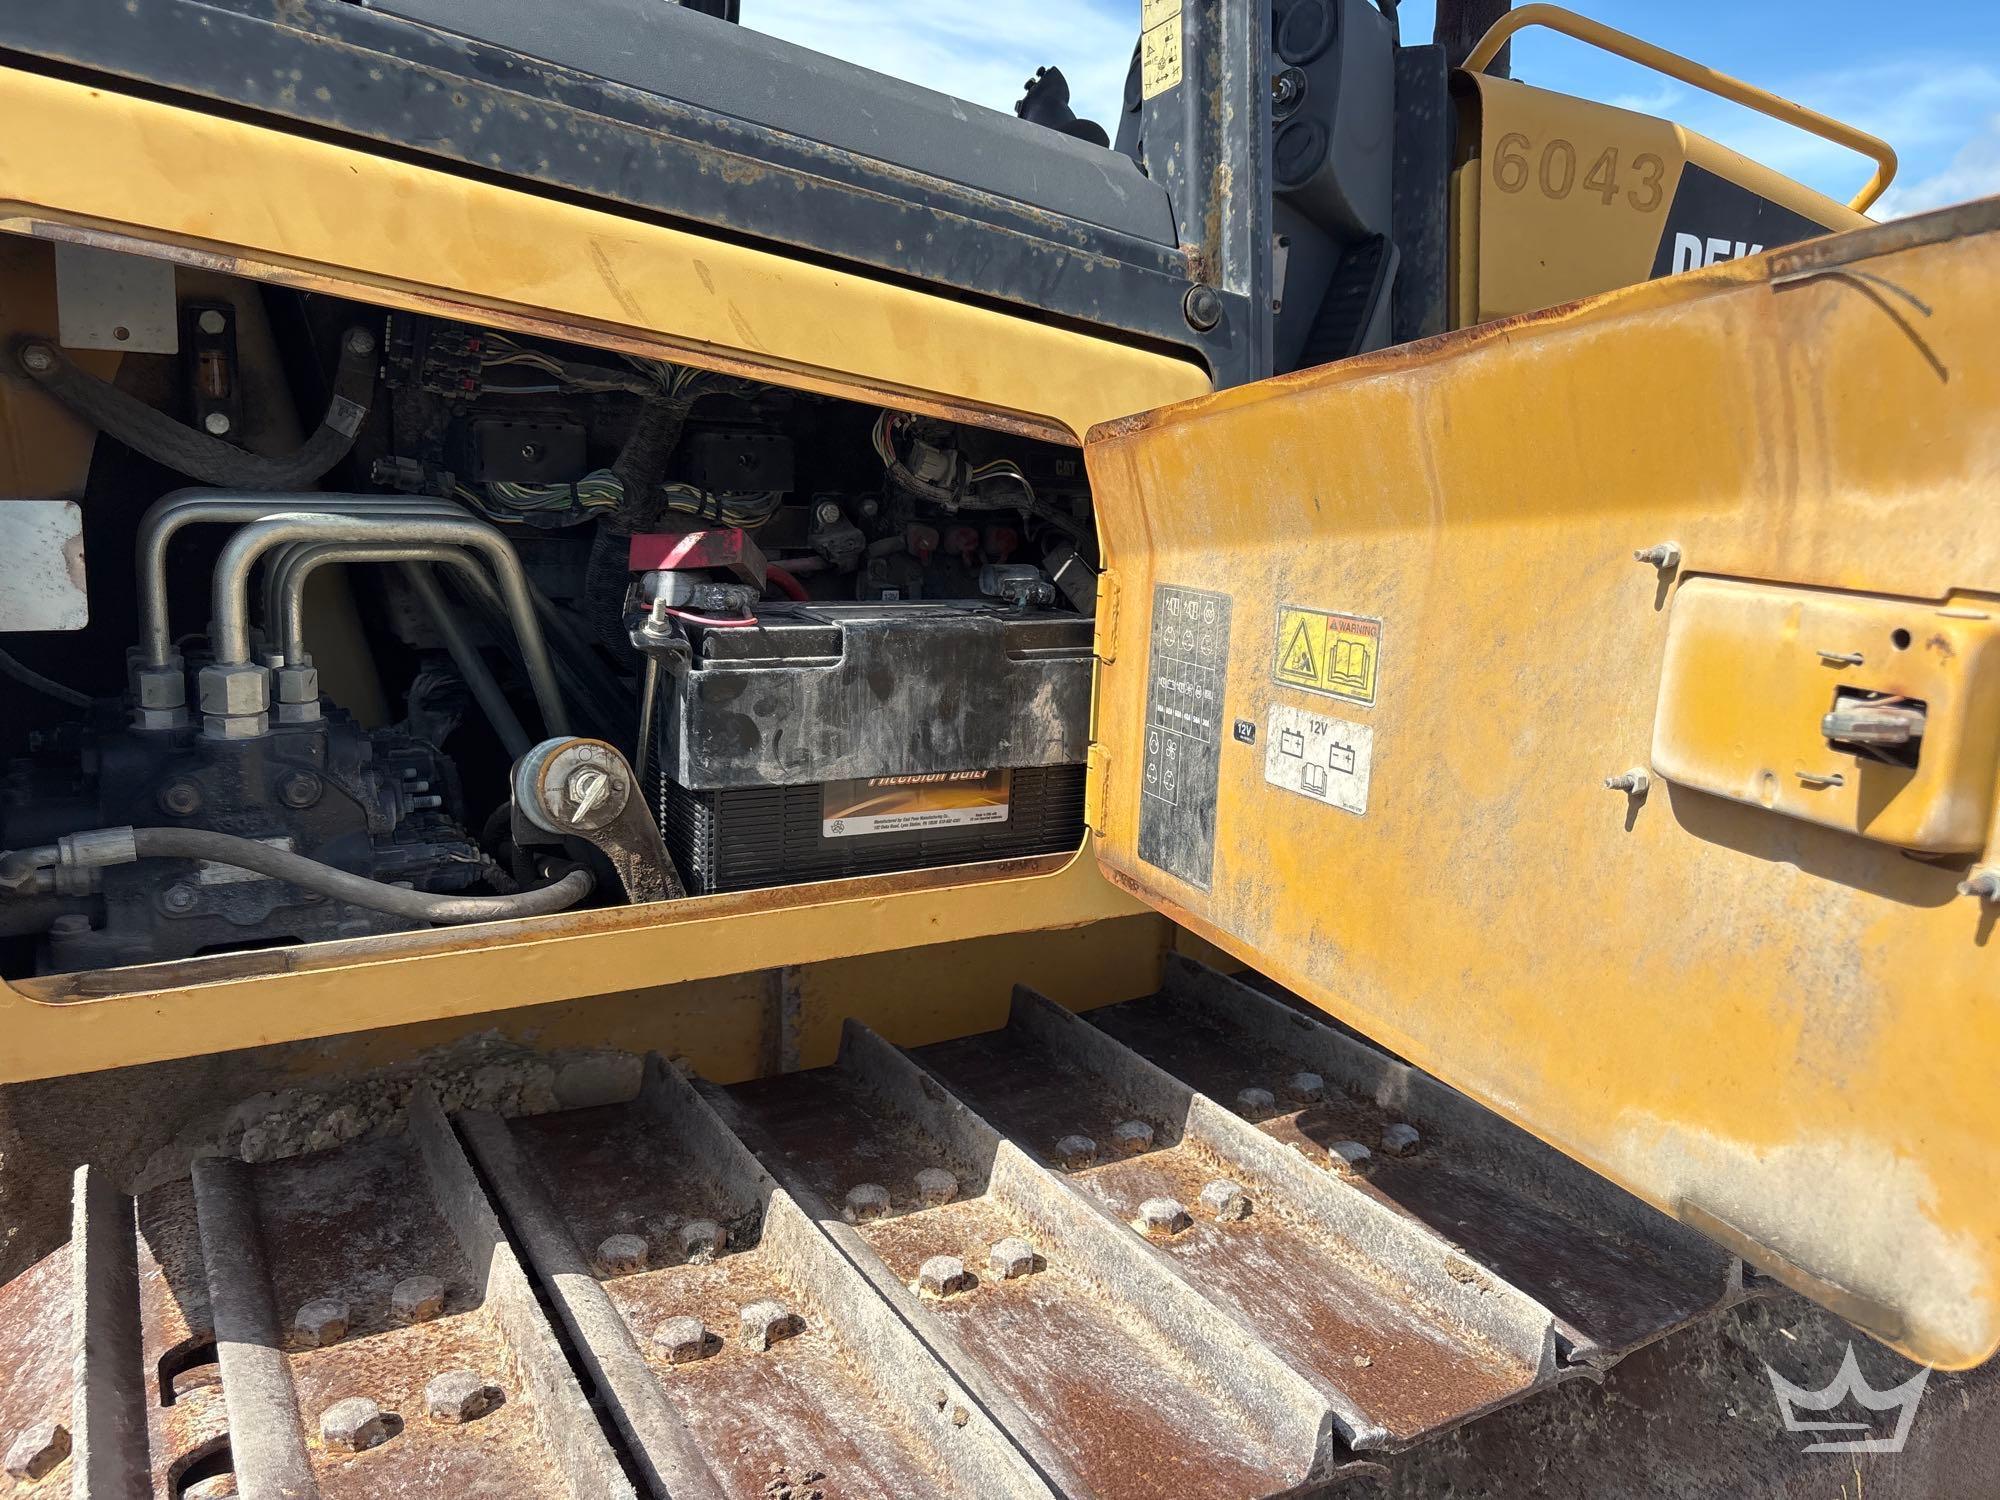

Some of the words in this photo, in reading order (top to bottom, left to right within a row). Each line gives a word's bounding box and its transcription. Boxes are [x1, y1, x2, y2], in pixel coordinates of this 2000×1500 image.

[1492, 132, 1665, 213] 6043
[1339, 621, 1377, 636] WARNING
[1237, 723, 1252, 736] 12V
[1309, 720, 1328, 736] 12V
